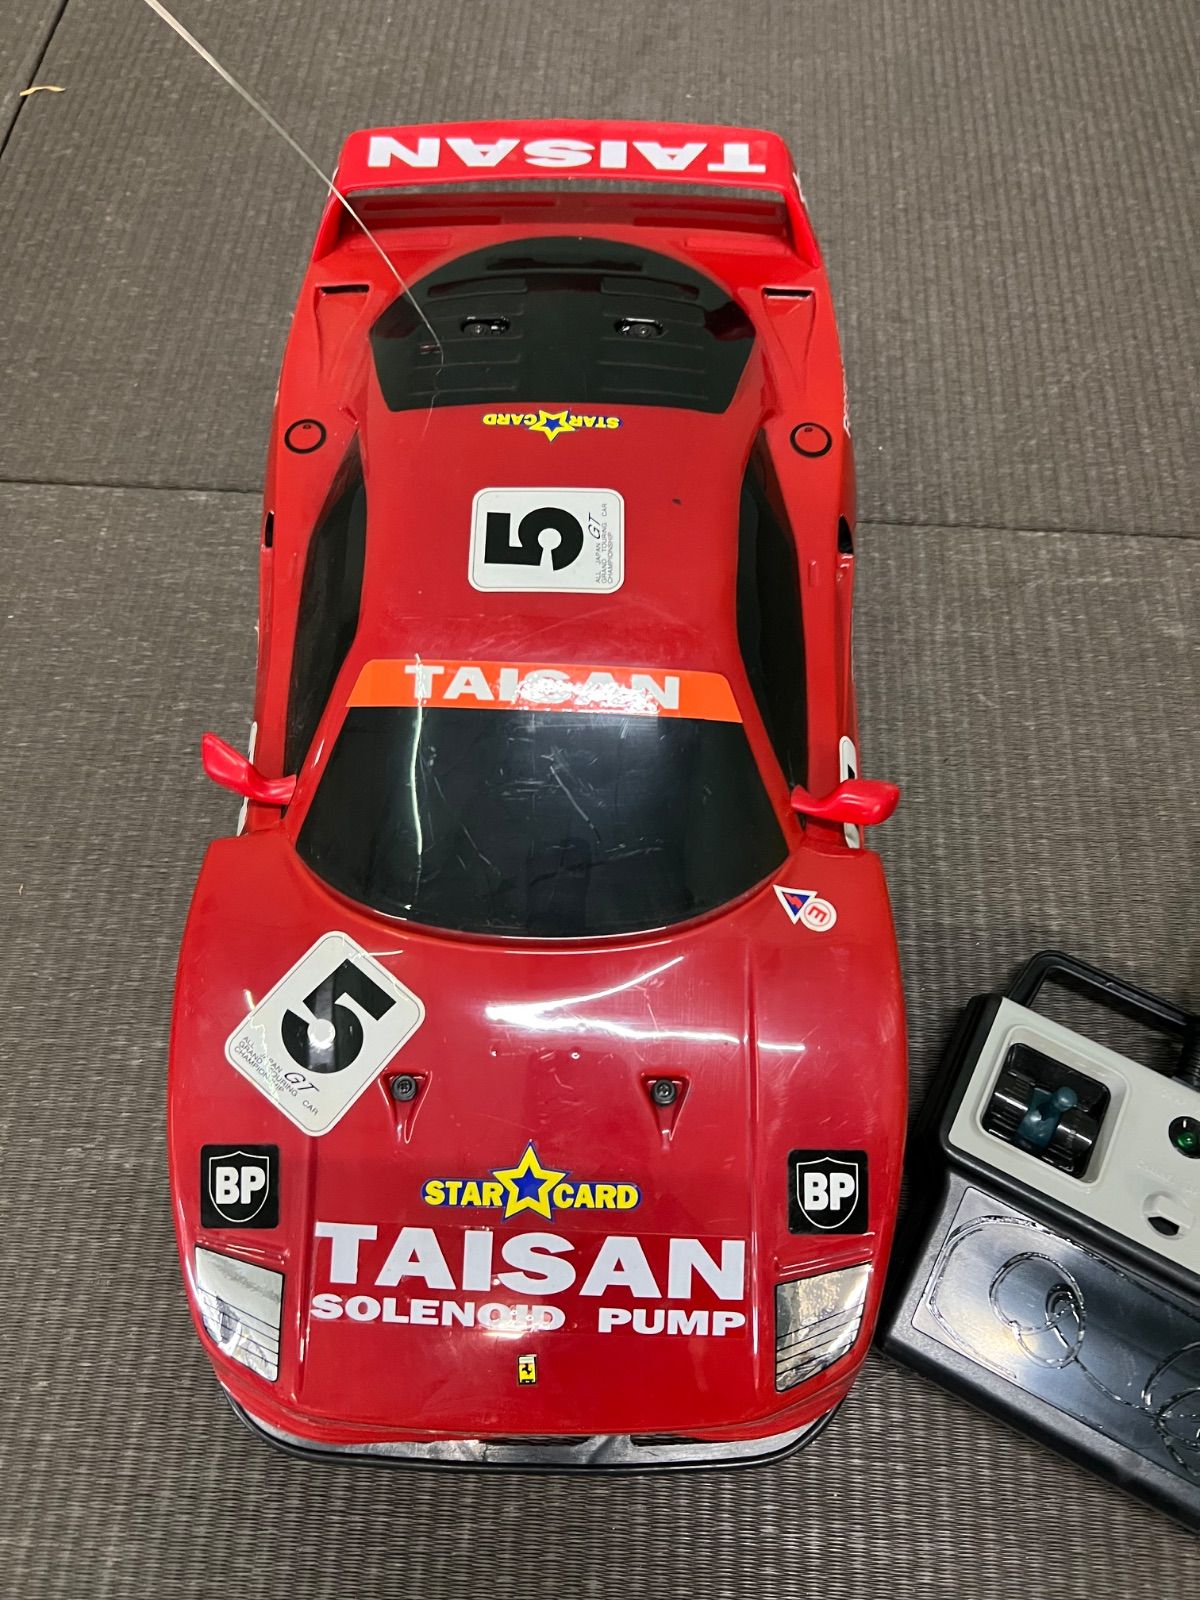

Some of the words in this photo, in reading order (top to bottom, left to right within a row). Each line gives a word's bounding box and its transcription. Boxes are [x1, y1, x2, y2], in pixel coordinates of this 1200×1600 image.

[367, 135, 767, 173] TAISAN
[483, 413, 537, 426] CARD
[569, 415, 620, 429] STAR
[484, 506, 585, 571] 5
[588, 511, 601, 540] GT
[281, 958, 397, 1074] 5
[239, 1040, 263, 1065] GRAND
[302, 1100, 319, 1116] CAR
[243, 1036, 255, 1049] ALL
[284, 1072, 320, 1092] GT
[215, 1166, 266, 1205] BP
[423, 1180, 503, 1207] STAR
[552, 1182, 639, 1210] CARD
[803, 1172, 856, 1211] BP
[314, 1221, 746, 1300] TAISAN
[310, 1293, 567, 1332] SOLENOID
[597, 1307, 746, 1337] PUMP
